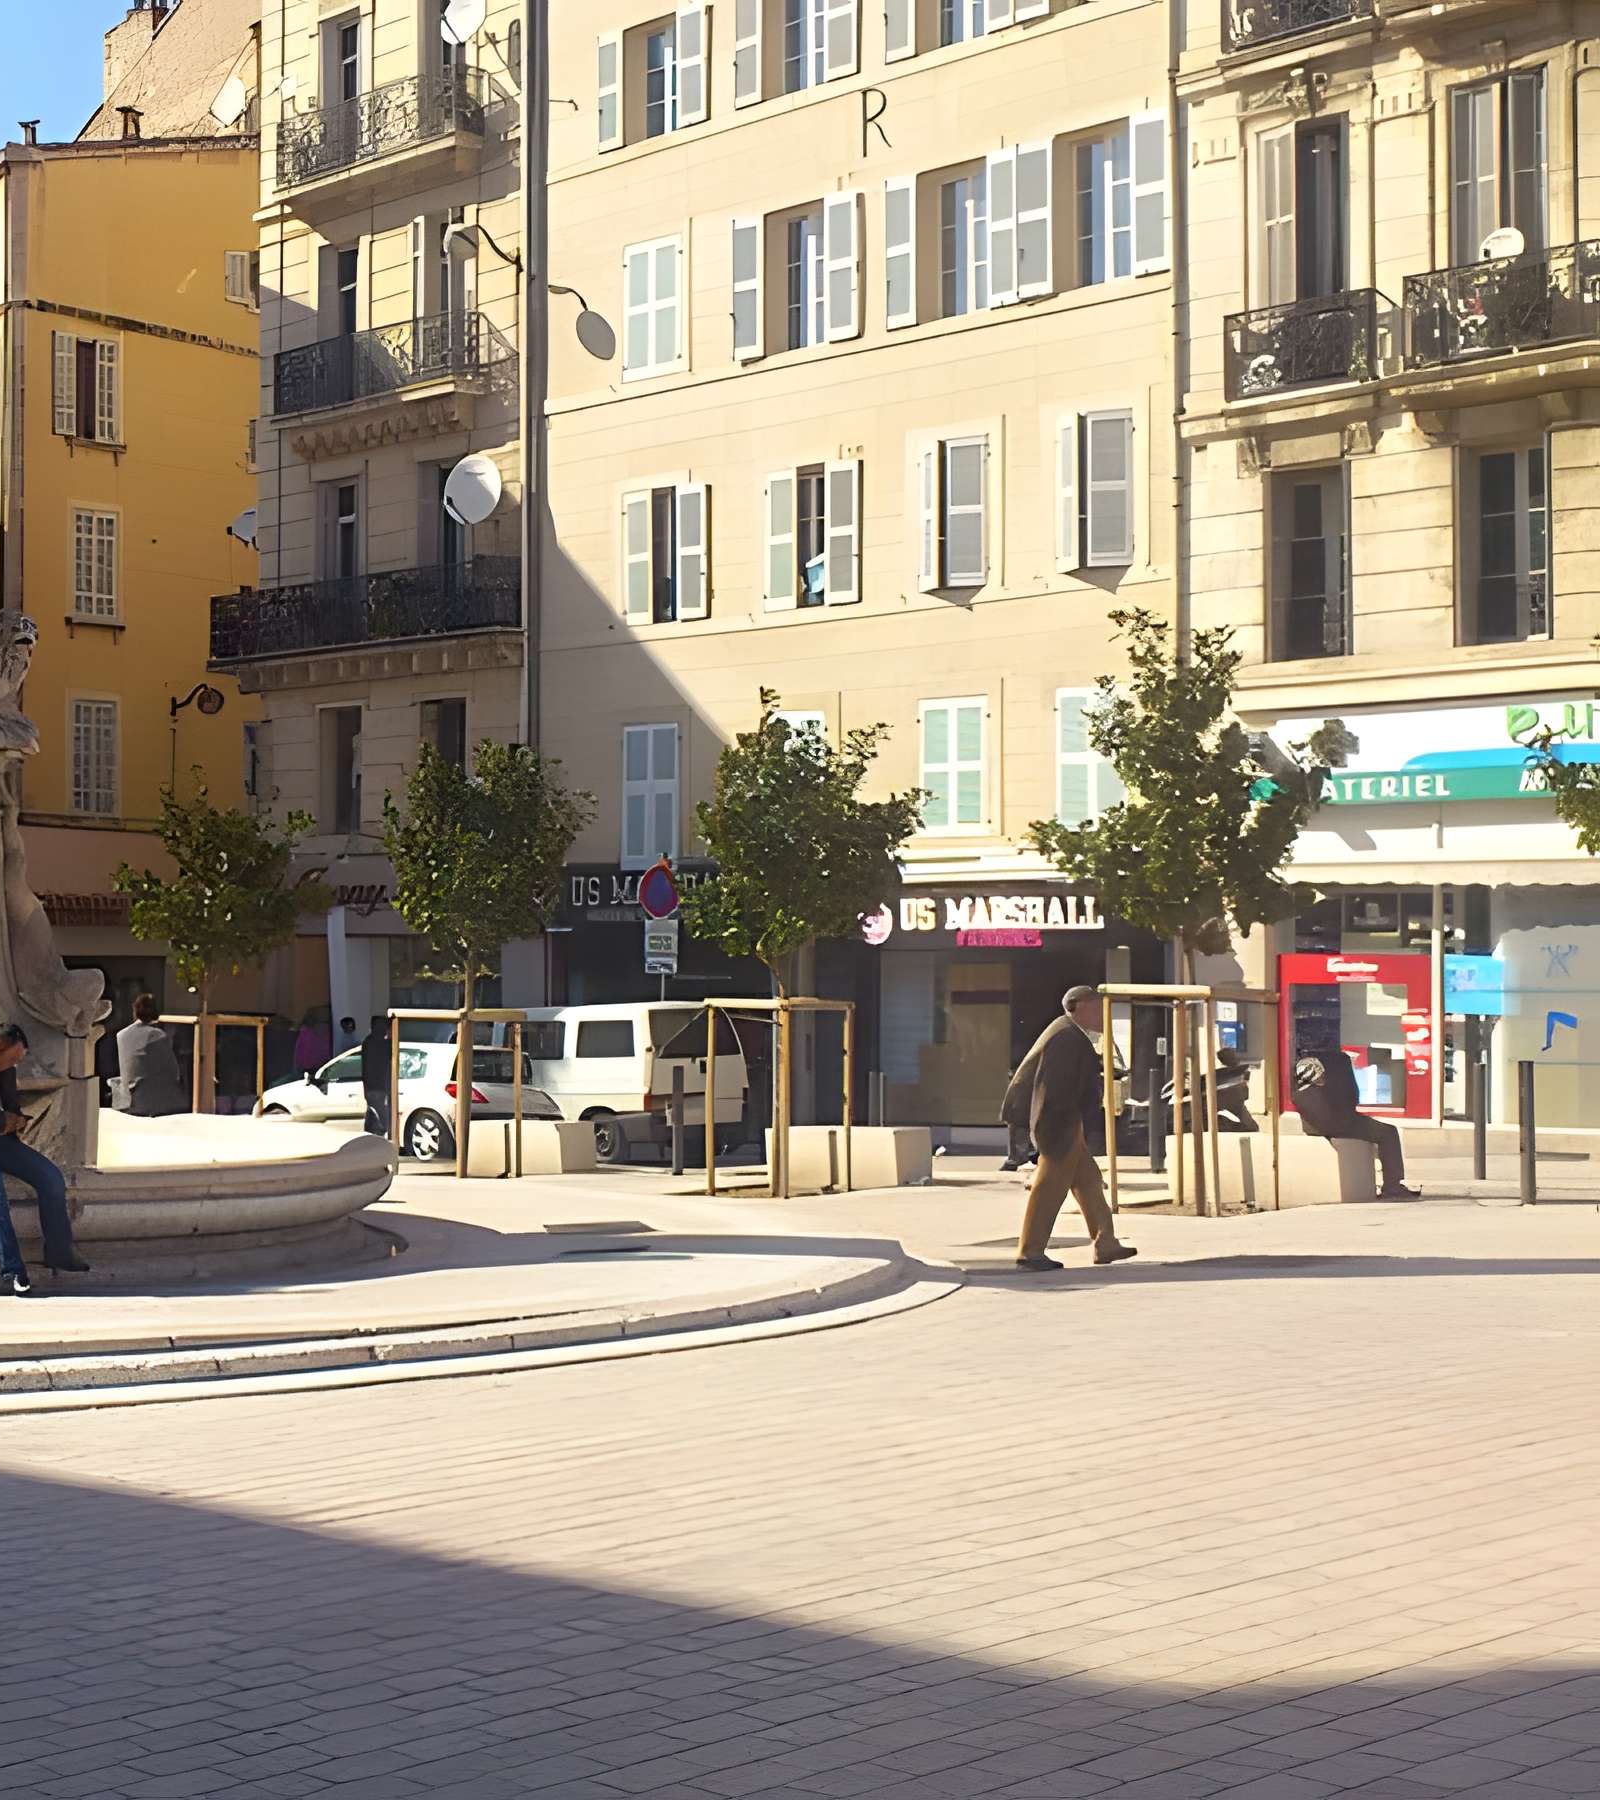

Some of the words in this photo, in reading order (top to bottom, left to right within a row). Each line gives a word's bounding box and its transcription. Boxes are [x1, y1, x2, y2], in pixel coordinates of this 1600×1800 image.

[1318, 773, 1451, 801] ATERIEL
[900, 898, 937, 931] US
[945, 895, 1105, 931] MARSHALL
